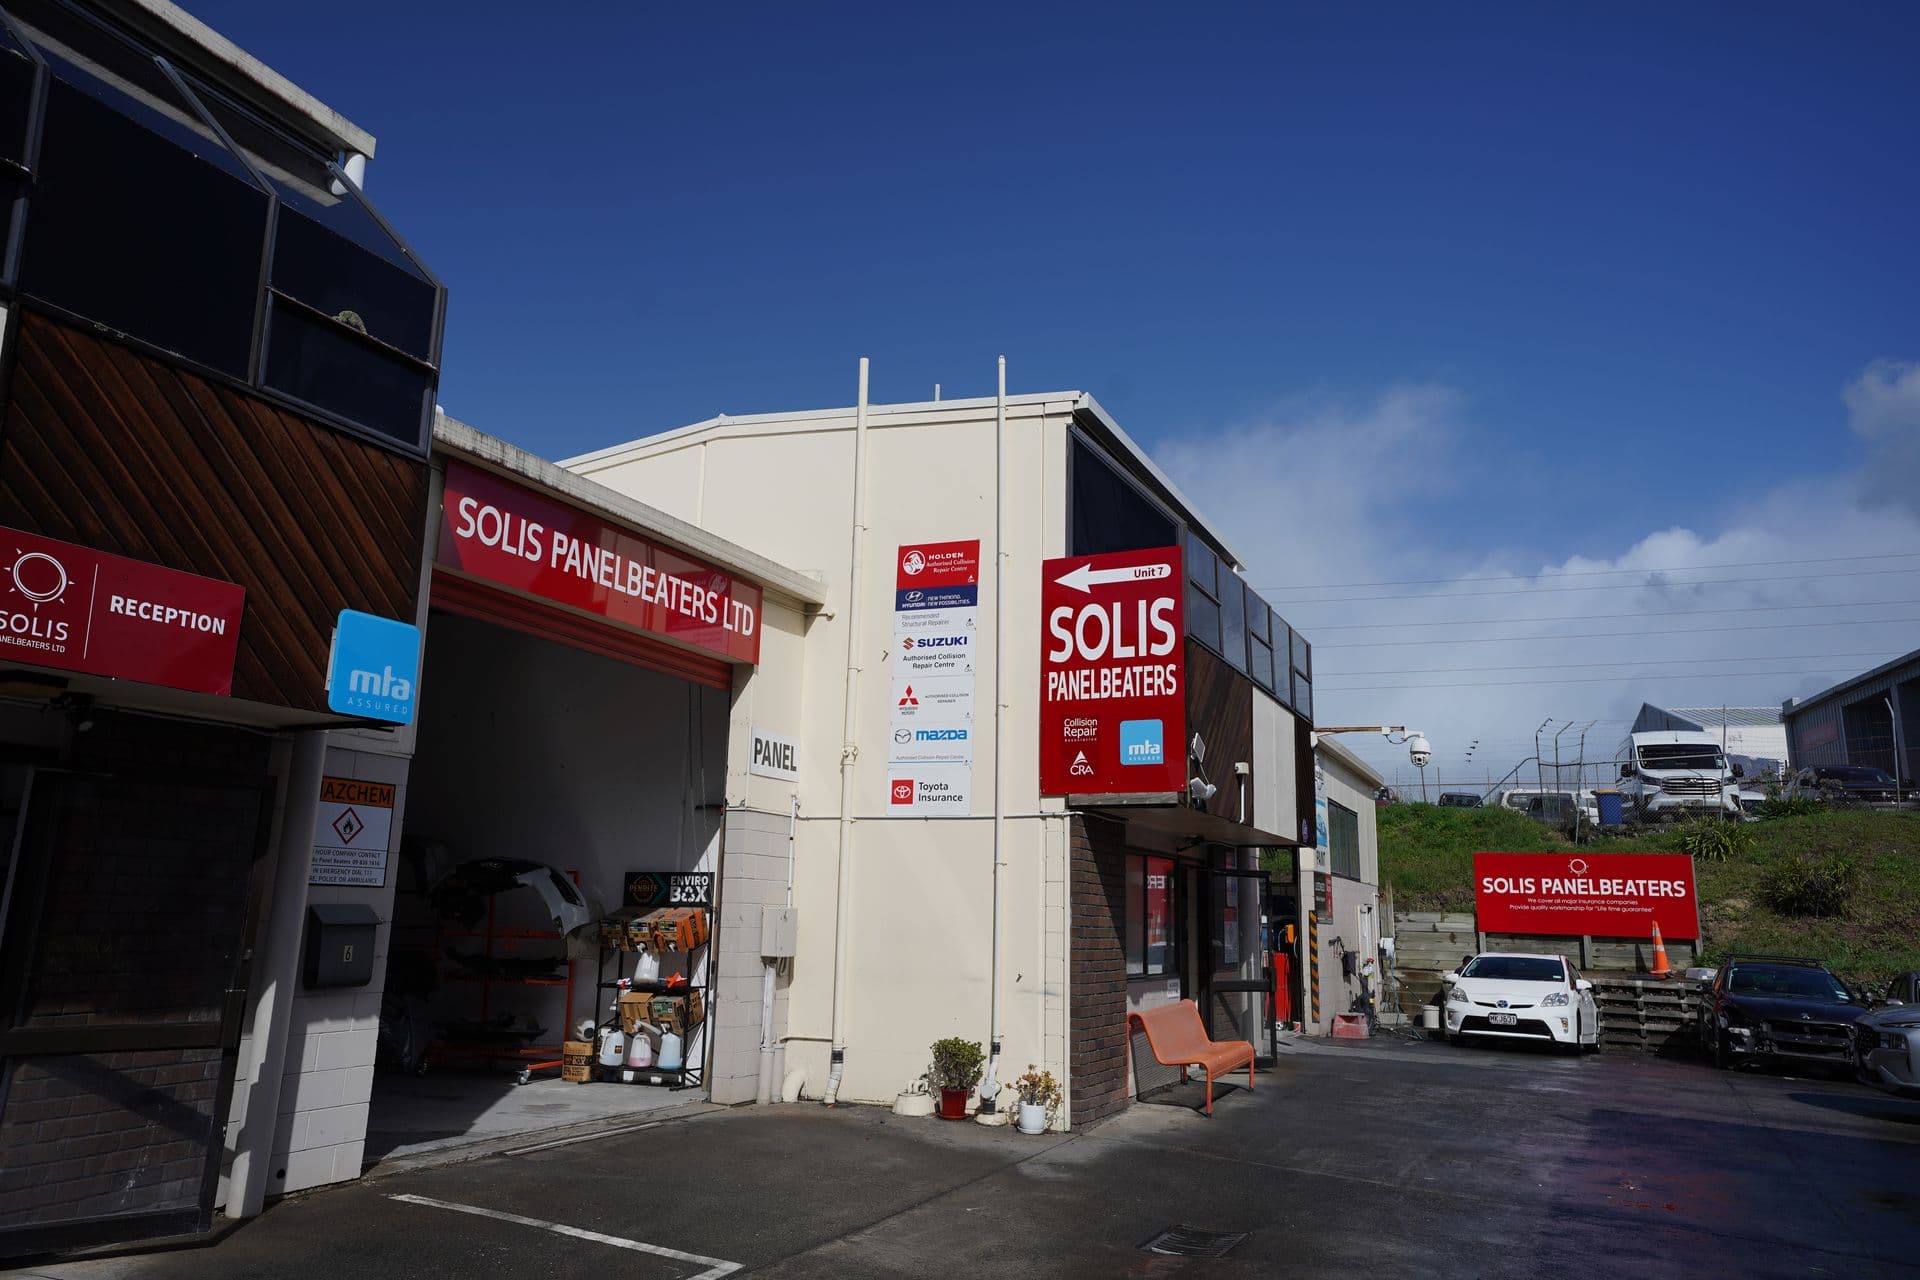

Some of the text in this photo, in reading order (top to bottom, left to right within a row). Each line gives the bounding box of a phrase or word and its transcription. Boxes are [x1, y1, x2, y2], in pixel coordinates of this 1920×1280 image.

[929, 552, 964, 560] HOLDEN
[456, 496, 755, 637] SOLIS PANELBEATERS LTD
[1134, 567, 1164, 578] Unit 7
[110, 595, 226, 635] RECEPTION
[0, 610, 69, 641] SOLIS
[1049, 597, 1176, 663] SOLIS
[51, 643, 66, 653] LTD
[917, 636, 968, 648] SUZUKI
[903, 654, 937, 662] Authorised
[349, 665, 411, 701] mta
[1048, 663, 1177, 701] PANELBEATERS
[347, 697, 408, 714] ASSURED
[1063, 718, 1098, 727] Collision
[916, 729, 968, 741] mazda
[1063, 726, 1098, 738] Repair
[1128, 740, 1160, 755] mta
[754, 737, 797, 772] PANEL
[1070, 765, 1094, 776] CRA
[321, 781, 391, 805] AZCHEM
[918, 782, 949, 792] Toyota
[918, 793, 963, 802] Insurance
[671, 875, 709, 886] ENVIRO
[1483, 877, 1686, 898] SOLIS PANELBEATERS
[345, 946, 351, 961] 6
